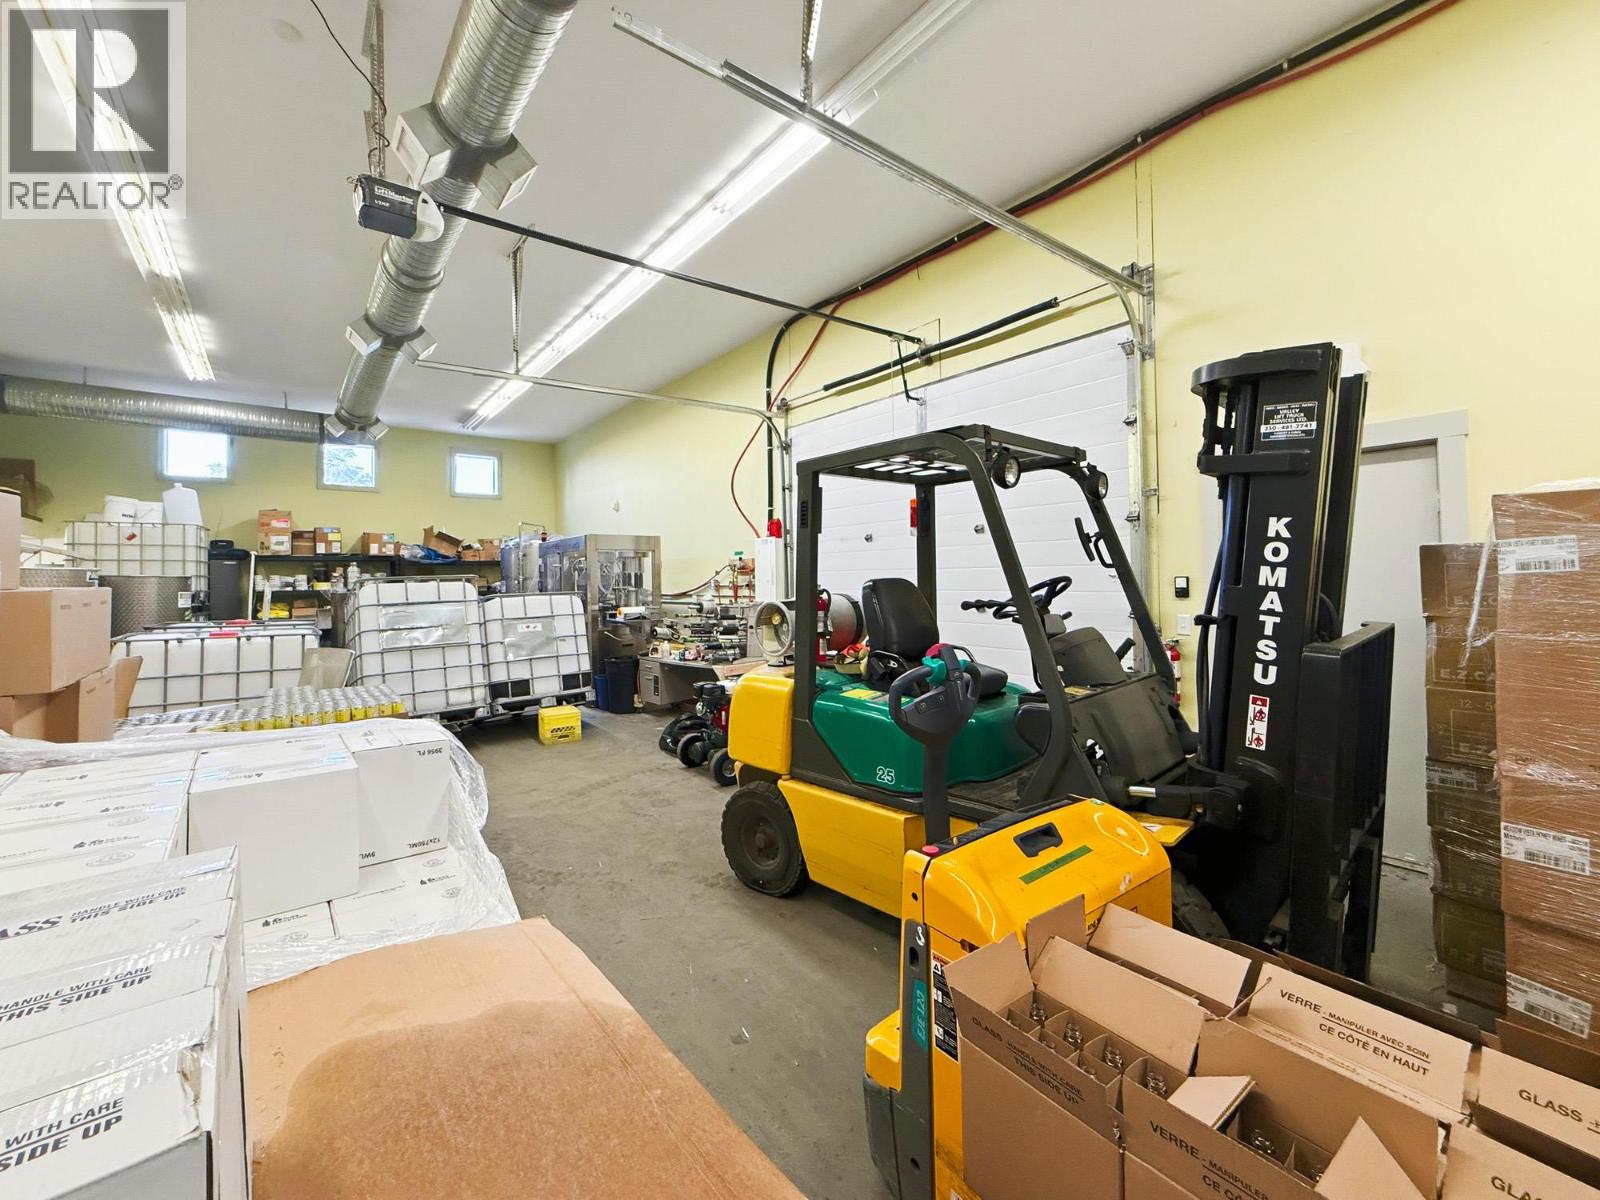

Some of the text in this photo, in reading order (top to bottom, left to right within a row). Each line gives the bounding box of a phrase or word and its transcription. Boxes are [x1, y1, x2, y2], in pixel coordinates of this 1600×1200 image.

[1253, 516, 1293, 686] KOMATSU
[877, 766, 895, 784] 25
[70, 892, 186, 923] THIS SIDE UP
[58, 986, 113, 1006] SIDE
[122, 975, 151, 988] UP
[70, 977, 110, 992] WITH
[114, 966, 152, 980] CARE
[972, 1016, 1003, 1041] GLASS
[1280, 989, 1322, 1014] VERRE
[1328, 1012, 1379, 1038] MANIPULER
[1381, 1034, 1405, 1049] AVEC
[1406, 1045, 1429, 1059] SOIN
[1319, 1023, 1334, 1036] CE
[1338, 1030, 1370, 1051] CÔTÉ
[1372, 1047, 1390, 1060] EN
[1393, 1056, 1430, 1077] HAUT
[1519, 1089, 1583, 1122] GLASS
[5, 1097, 124, 1149] WITH CARE
[81, 1115, 123, 1140] UP
[1149, 1120, 1201, 1160] VERRE
[1202, 1175, 1221, 1194] CE
